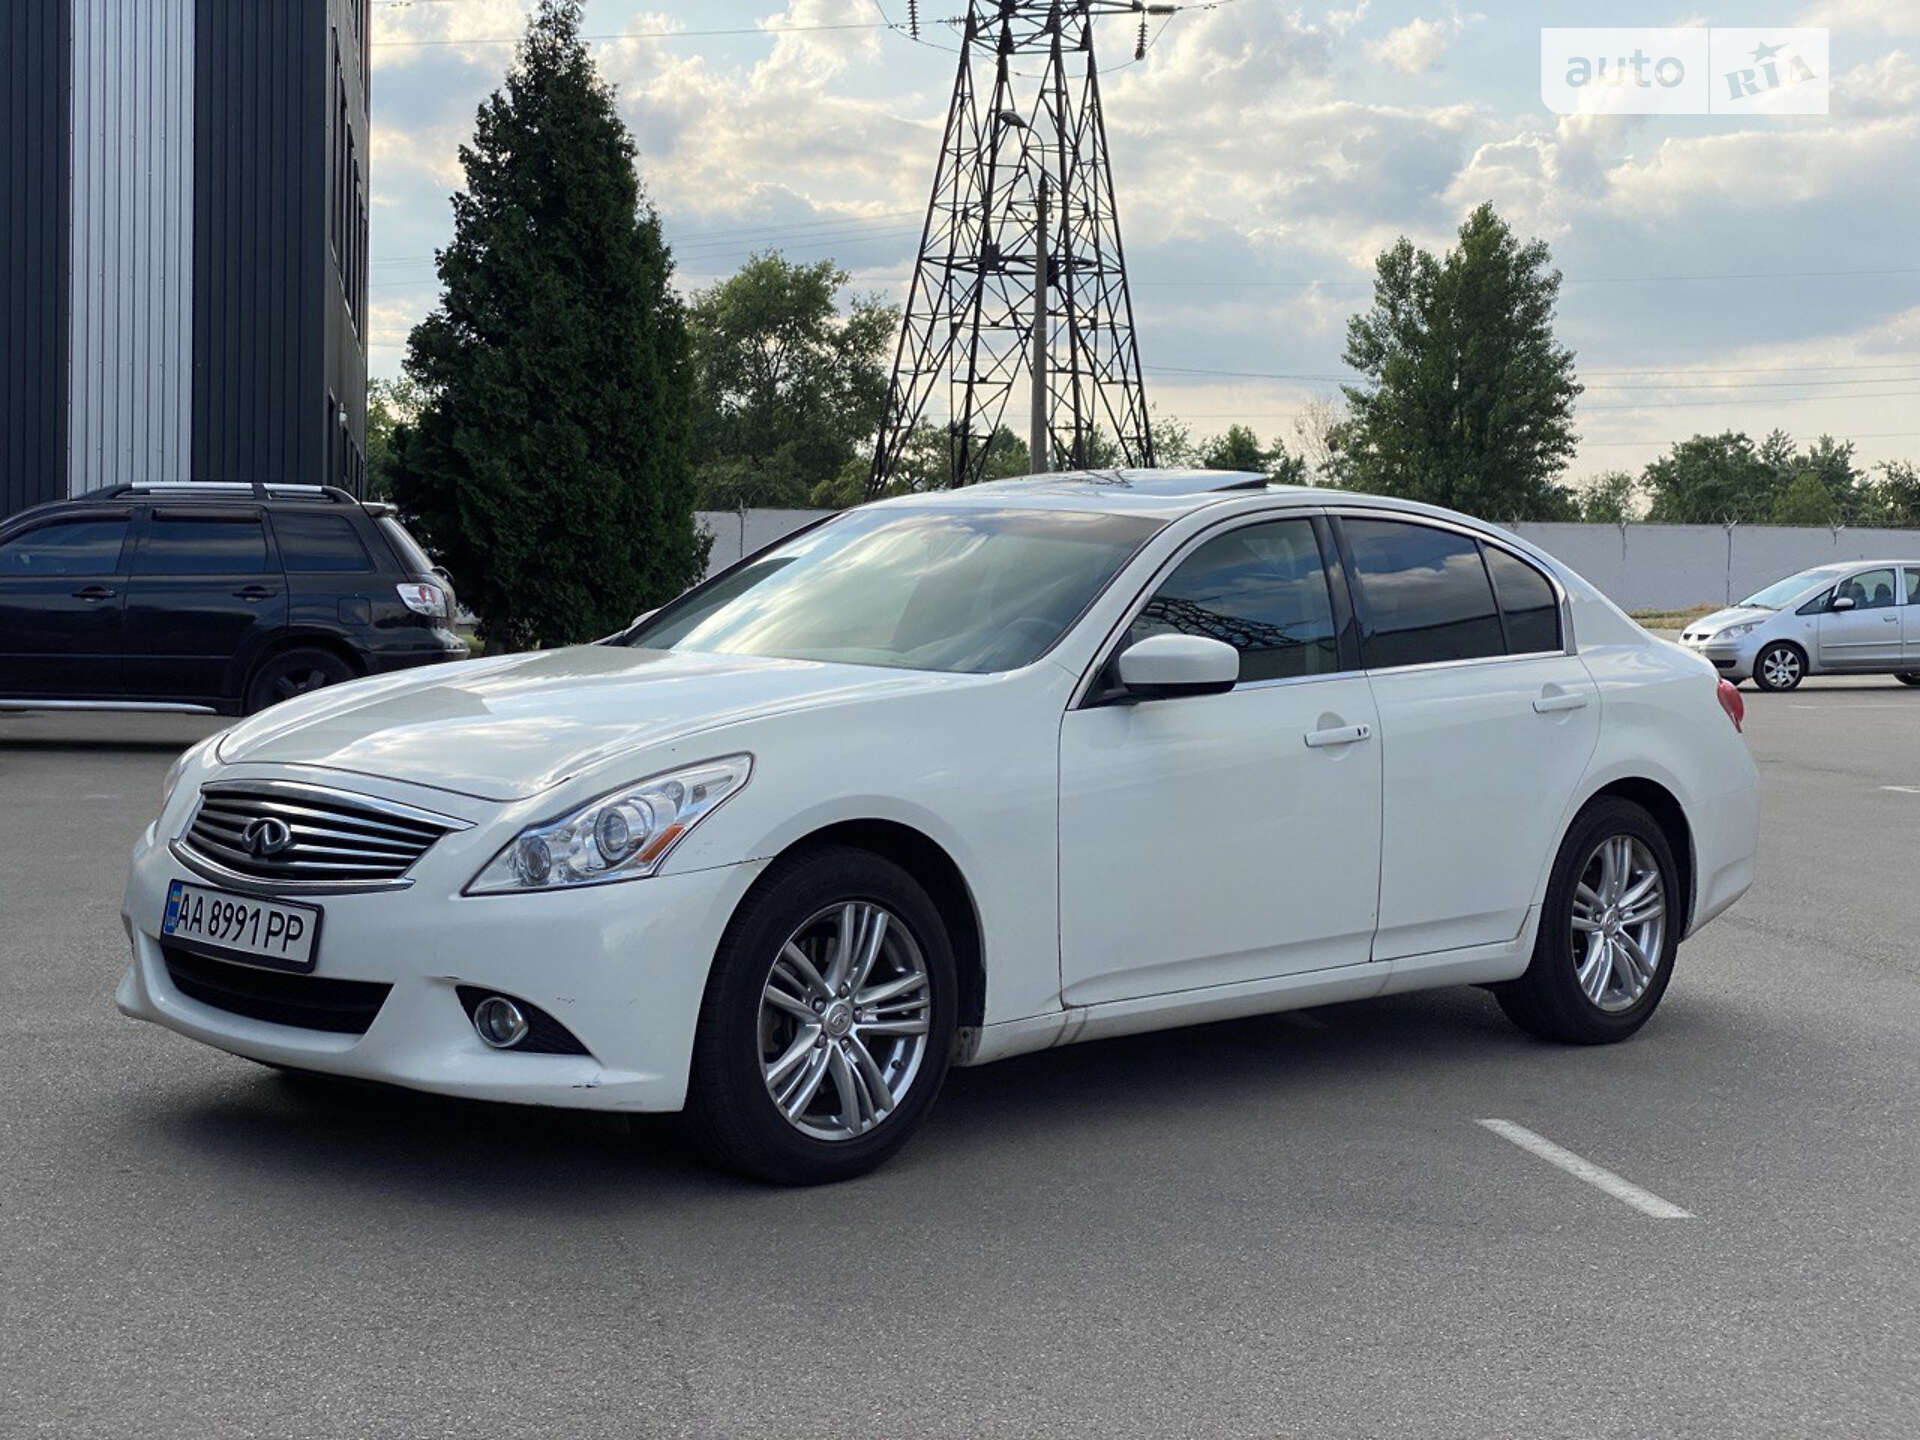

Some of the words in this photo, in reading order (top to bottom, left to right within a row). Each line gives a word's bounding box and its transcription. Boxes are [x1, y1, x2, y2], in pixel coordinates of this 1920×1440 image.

[176, 893, 204, 934] AA
[208, 900, 262, 946] 8991
[263, 910, 304, 953] PP
